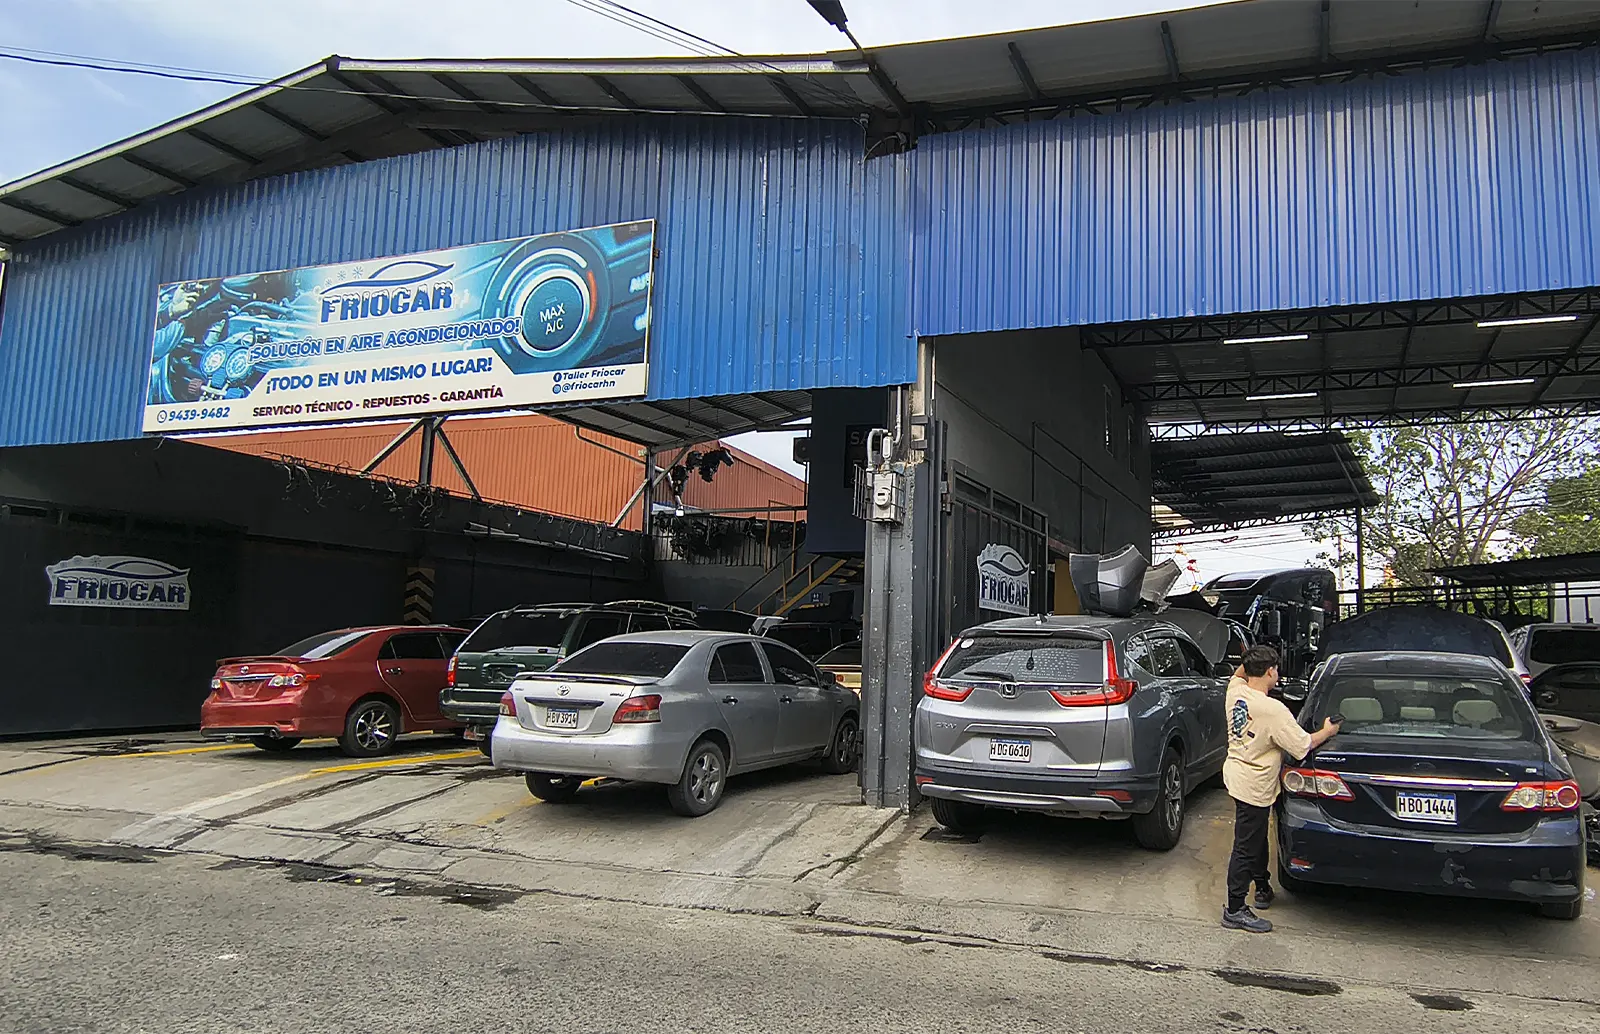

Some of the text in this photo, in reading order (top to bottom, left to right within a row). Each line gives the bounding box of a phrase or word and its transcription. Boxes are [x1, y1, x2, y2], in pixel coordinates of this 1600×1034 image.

[320, 280, 454, 323] FRIOCAR
[539, 303, 566, 323] MAX
[250, 318, 520, 361] ¡SOLUCIÓN EN AIRE ACONDICIONADO!
[545, 317, 564, 335] A/C
[266, 357, 493, 394] ¡TODO EN UN MISMO LUGAR!
[562, 379, 616, 393] @friocarhn
[563, 368, 626, 380] Taller Friocar
[168, 406, 231, 422] 9439-9482
[252, 404, 303, 417] SERVICIO
[305, 401, 353, 413] TÉCNICO
[362, 393, 430, 409] REPUESTOS
[439, 385, 504, 402] GARANTÍA
[55, 576, 187, 603] FRIOCAR
[981, 569, 1029, 608] FRIOCAR
